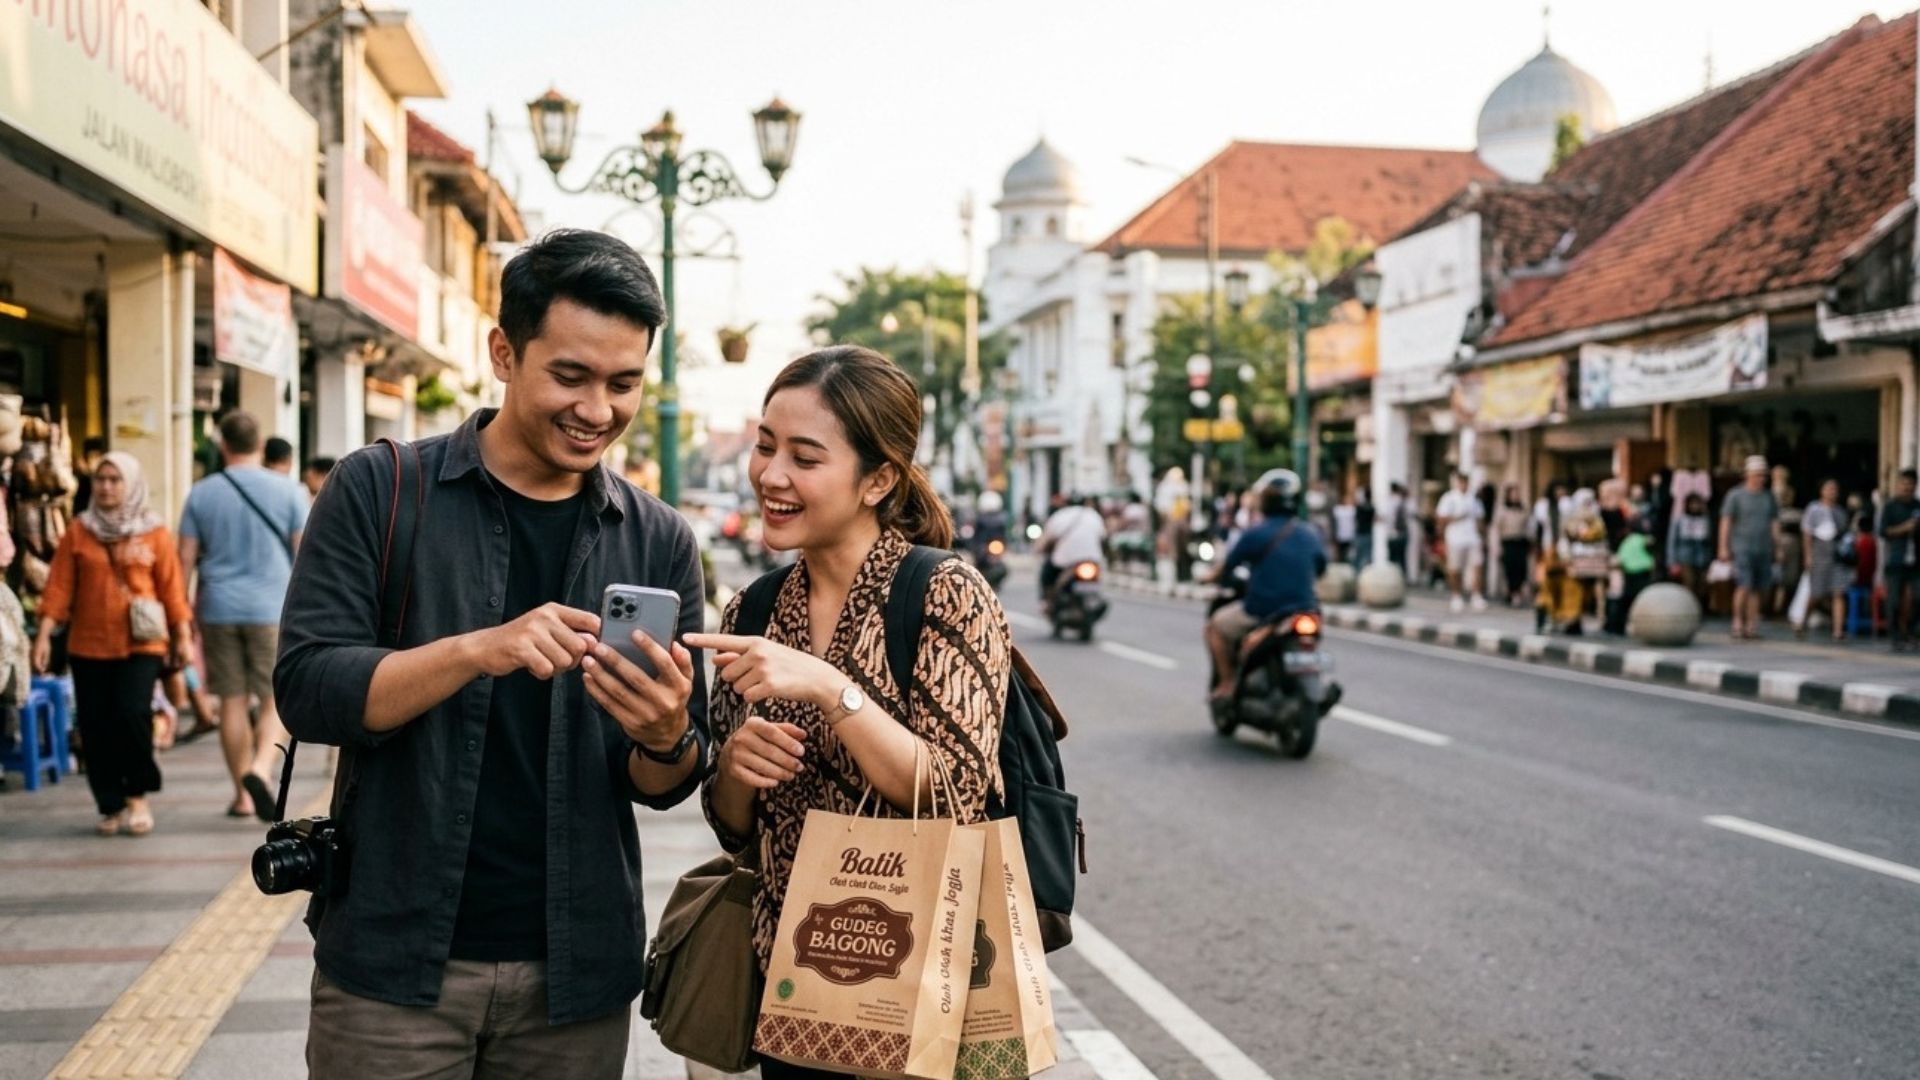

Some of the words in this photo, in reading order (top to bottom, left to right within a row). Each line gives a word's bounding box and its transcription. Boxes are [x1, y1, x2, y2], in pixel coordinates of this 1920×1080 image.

[81, 104, 129, 160] JALAN
[840, 847, 907, 878] Batik
[830, 917, 888, 935] GUDEG
[809, 930, 896, 957] BAGONG
